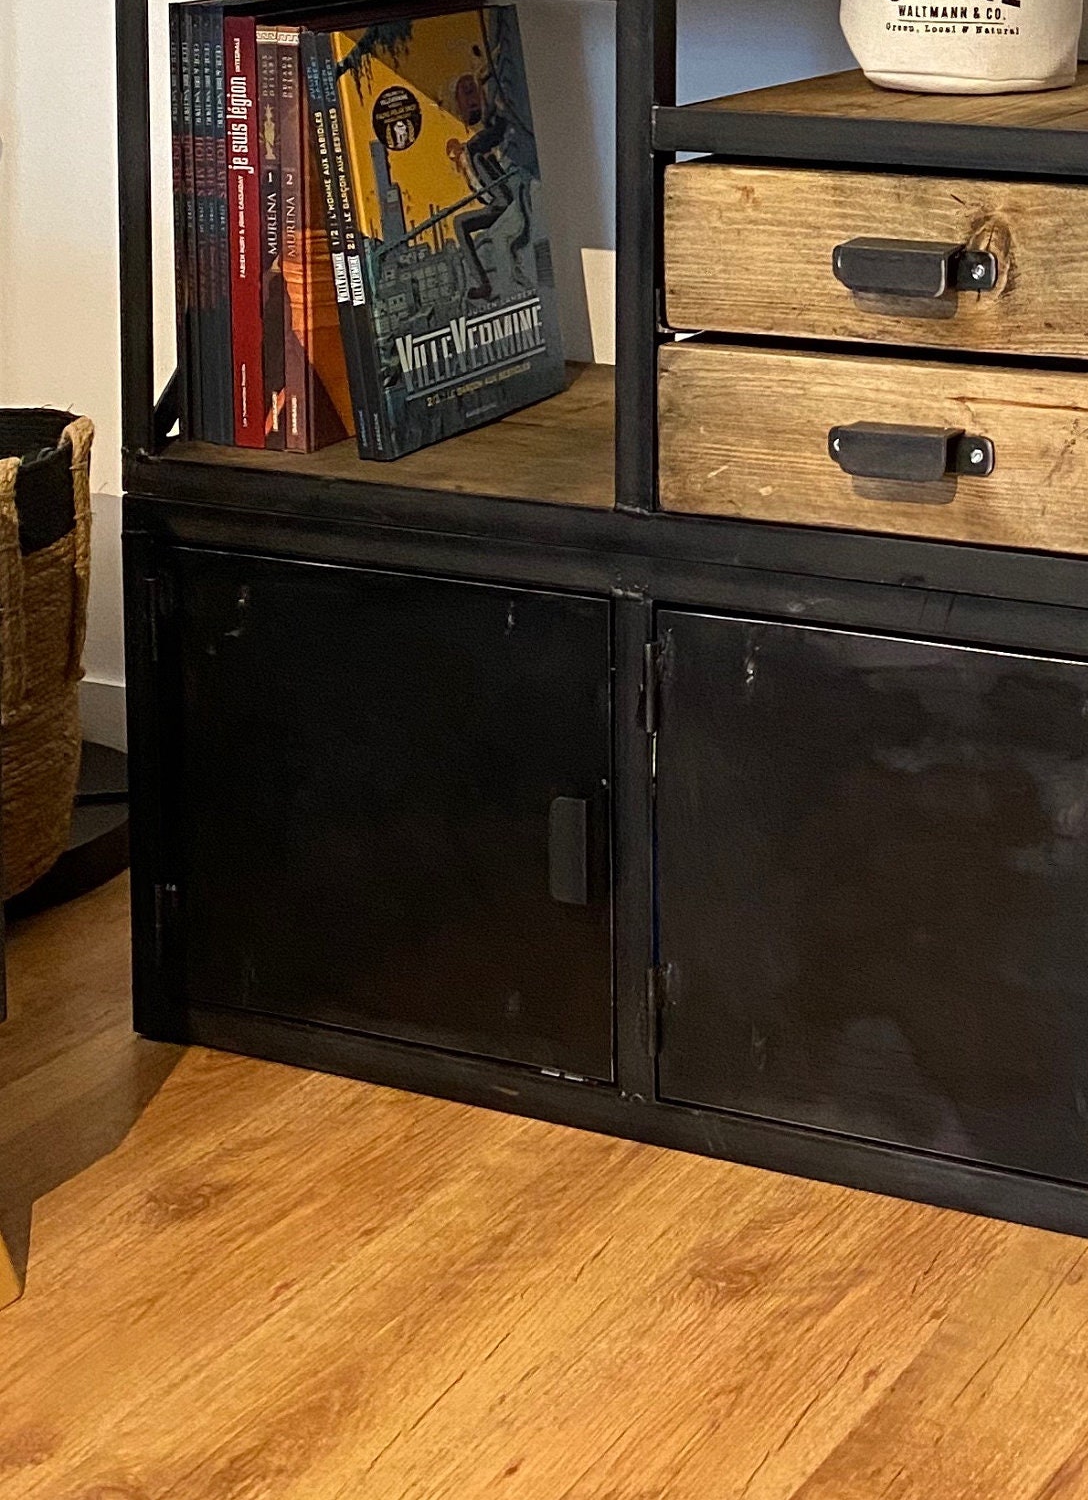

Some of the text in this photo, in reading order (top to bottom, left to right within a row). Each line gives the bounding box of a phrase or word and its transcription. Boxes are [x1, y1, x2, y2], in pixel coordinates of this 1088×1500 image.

[898, 5, 1006, 20] WALTMANN & CO.
[886, 22, 920, 33] Green,
[976, 26, 1019, 36] Natural
[226, 76, 254, 174] je suis légion
[314, 111, 328, 155] BABIOLES
[321, 157, 331, 175] AUX
[335, 155, 345, 172] AUX
[286, 173, 293, 185] 2
[267, 192, 279, 255] MURENA
[344, 210, 352, 222] LE
[286, 196, 297, 258] MURENA
